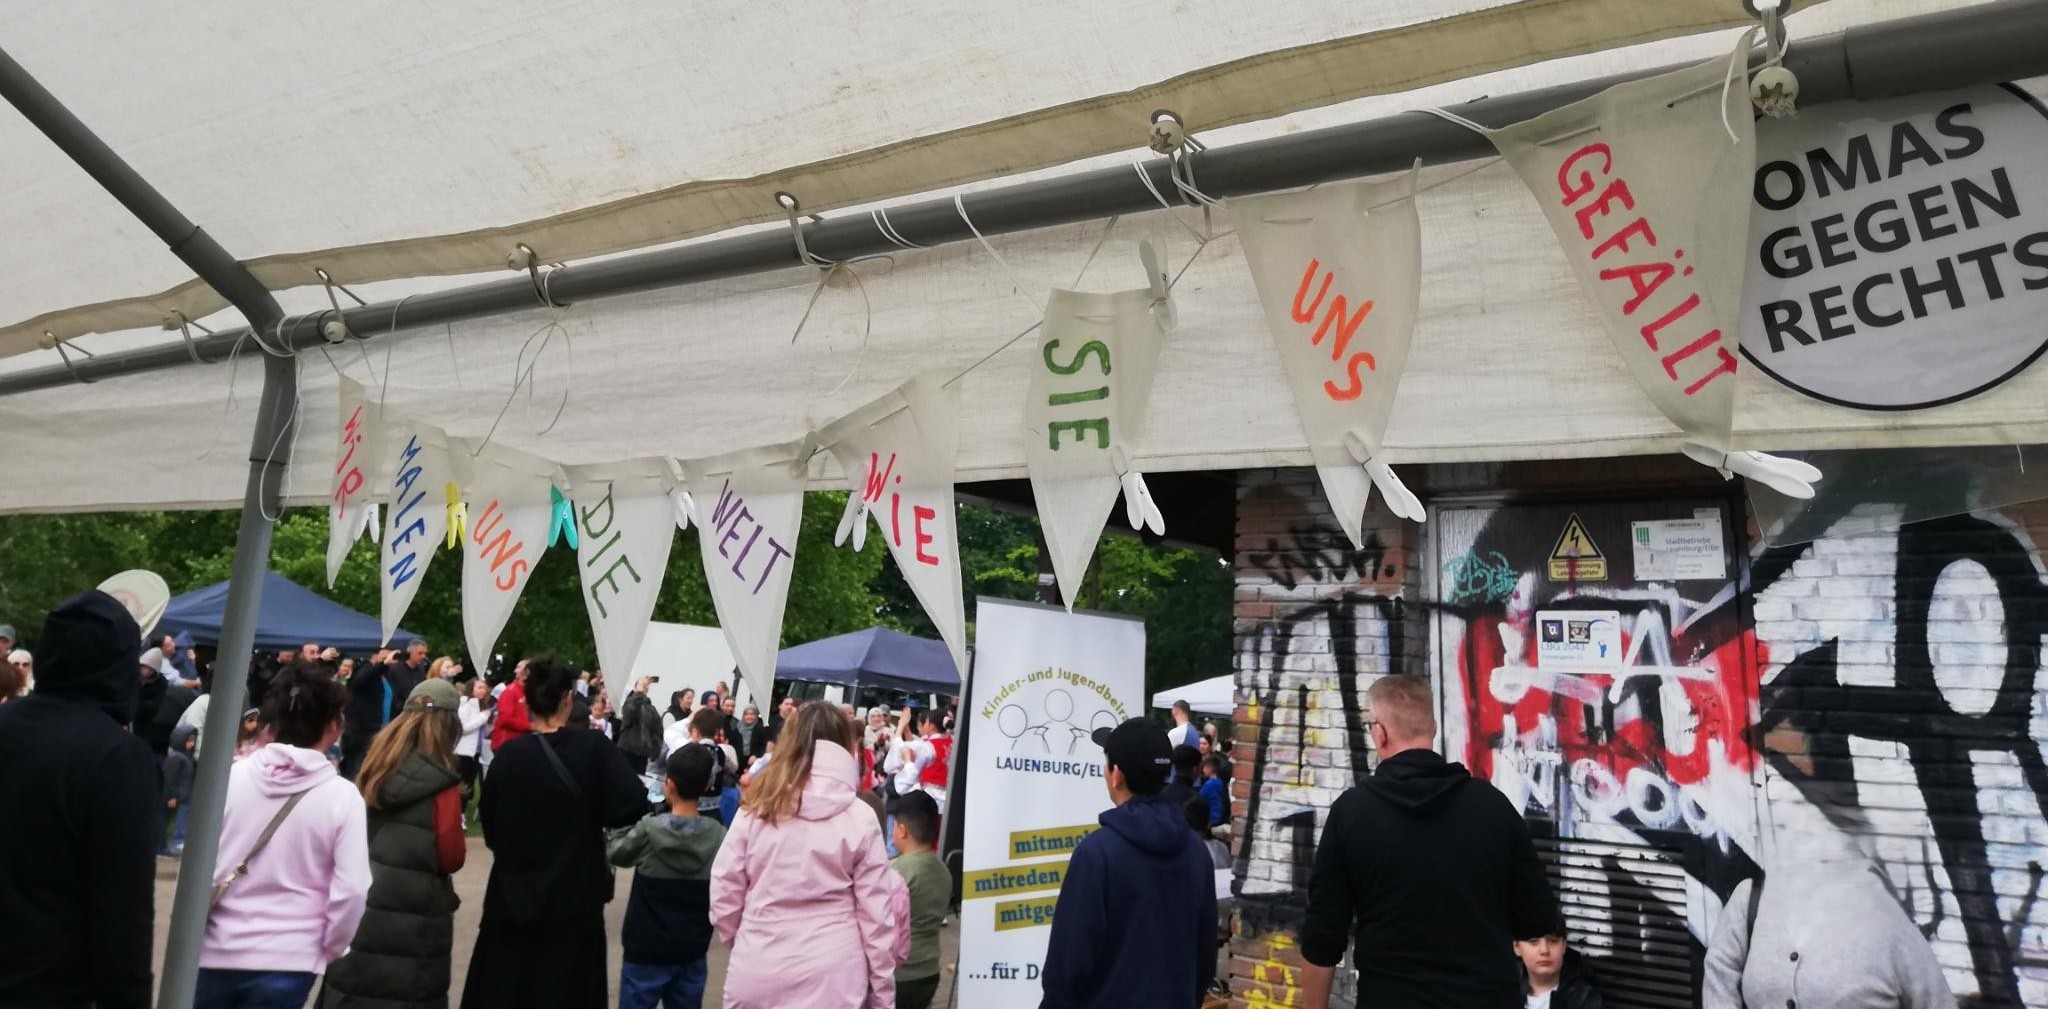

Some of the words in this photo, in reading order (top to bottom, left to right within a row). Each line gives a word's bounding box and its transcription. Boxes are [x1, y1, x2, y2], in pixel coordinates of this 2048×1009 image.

[1753, 103, 1985, 211] OMAS
[1759, 166, 2021, 279] GEGEN
[1759, 231, 2048, 354] RECHTS
[389, 434, 425, 591] MALEN
[473, 499, 528, 592] UNS
[579, 482, 641, 619] DIE
[709, 478, 791, 595] WELT
[1043, 339, 1111, 451] SIE
[1291, 258, 1376, 402] UNS
[1557, 142, 1738, 396] GEFÄLLT
[1056, 667, 1131, 722] Jugendbeira
[996, 755, 1105, 779] LAUENBURG/EL
[974, 869, 1061, 892] mitreden
